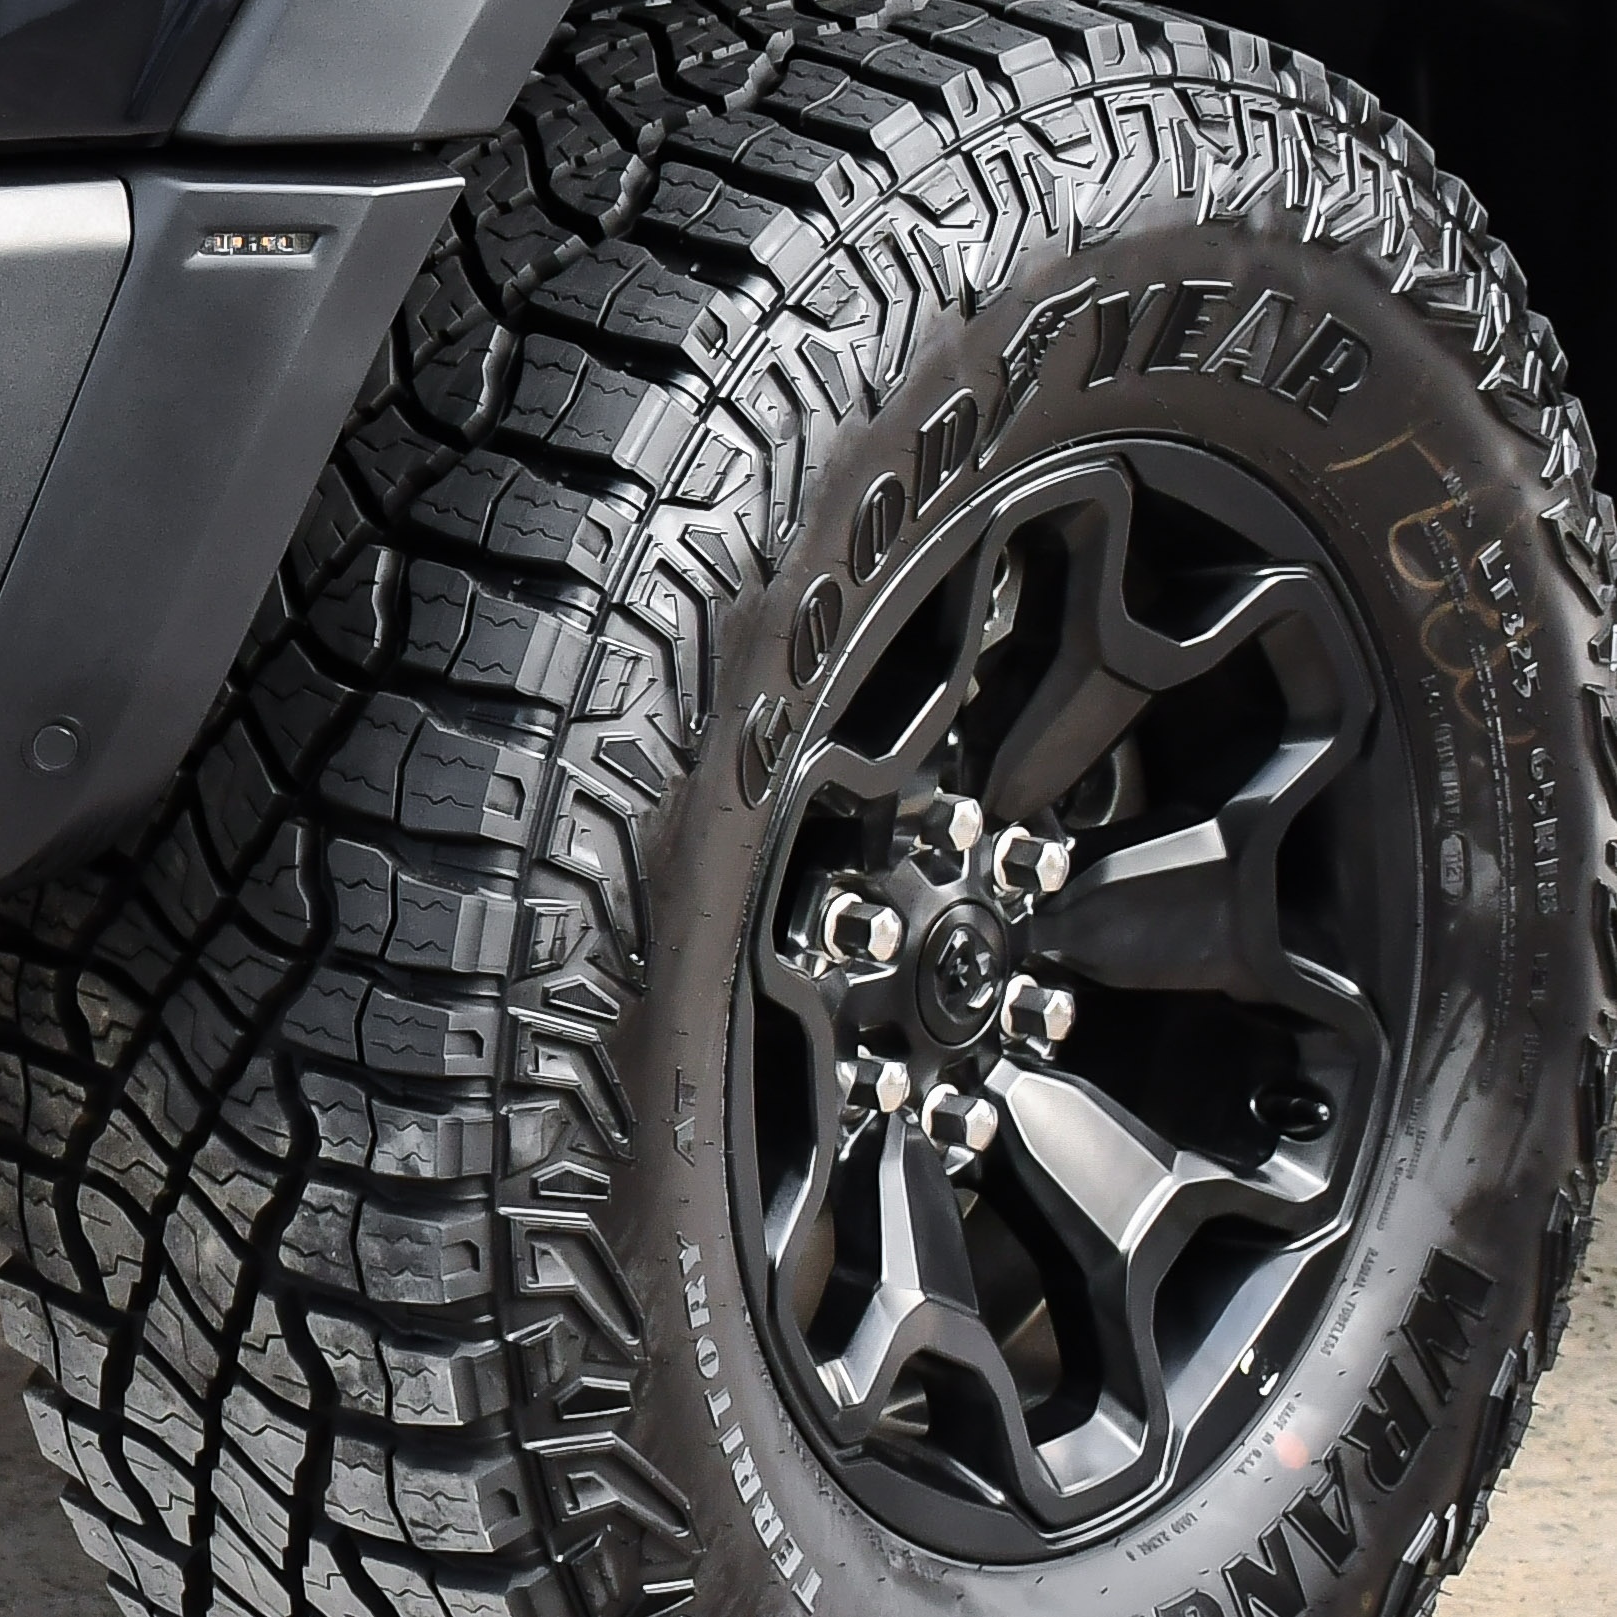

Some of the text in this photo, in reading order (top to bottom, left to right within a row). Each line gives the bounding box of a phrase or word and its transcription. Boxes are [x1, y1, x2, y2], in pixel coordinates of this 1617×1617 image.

[674, 1066, 822, 1615] TERRITORY AT
[1320, 1300, 1356, 1357] TUBELESS
